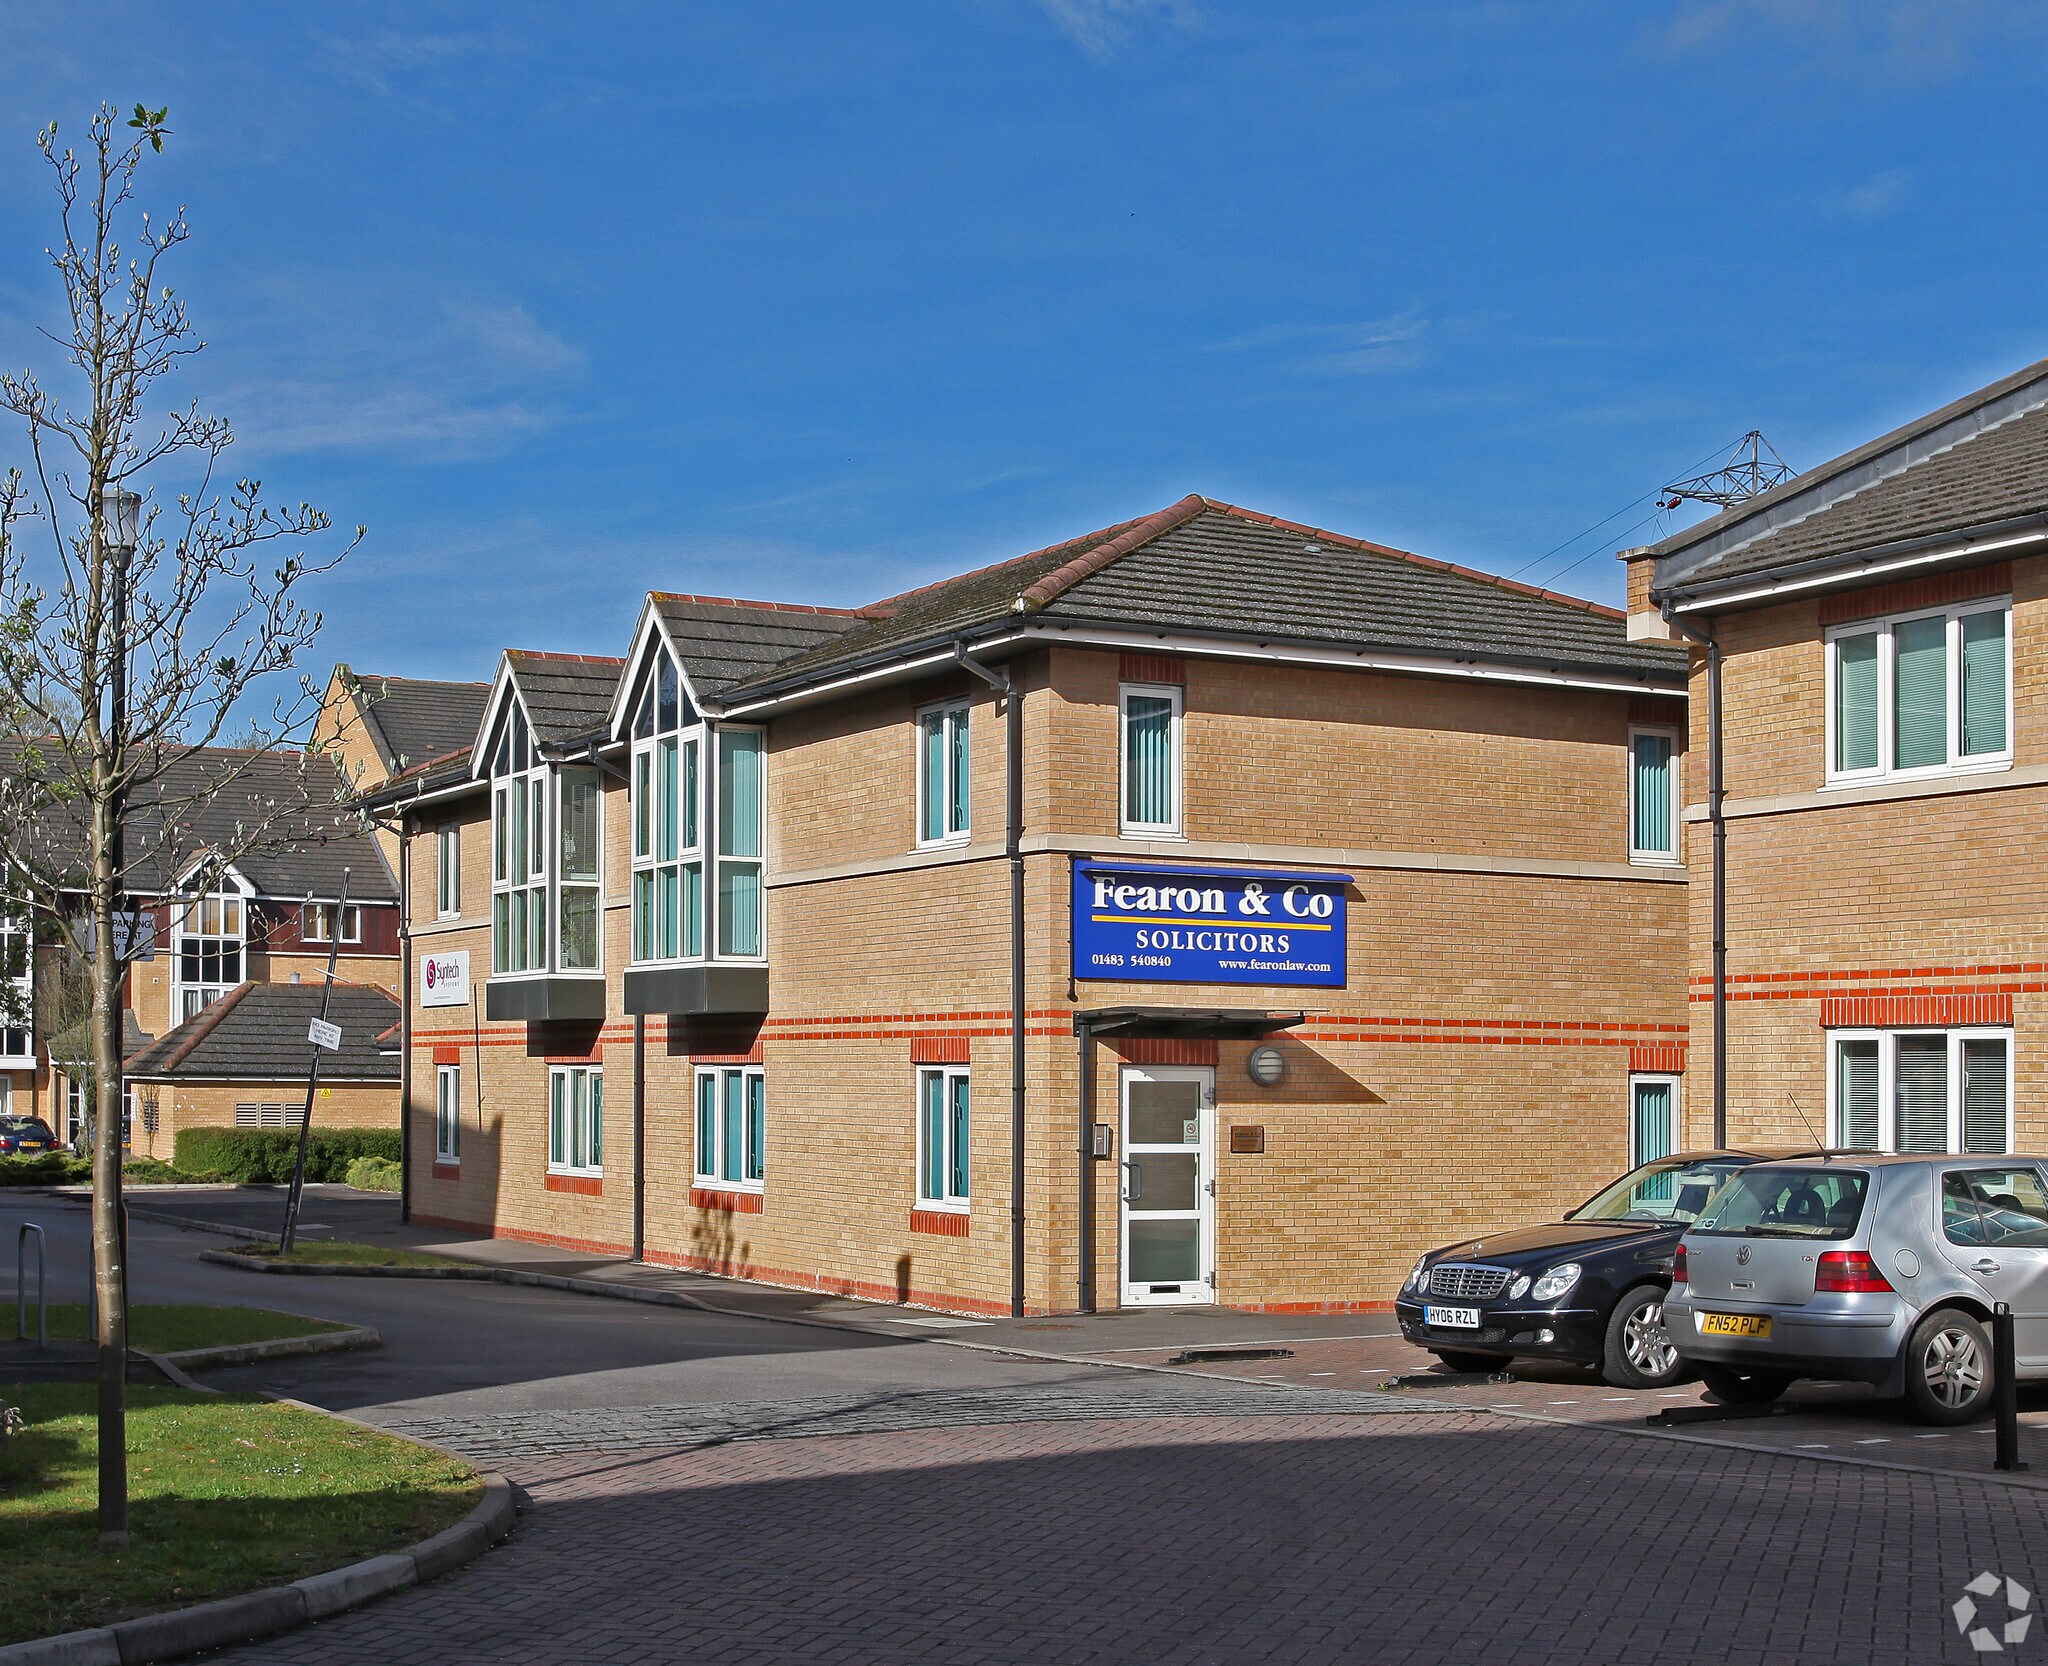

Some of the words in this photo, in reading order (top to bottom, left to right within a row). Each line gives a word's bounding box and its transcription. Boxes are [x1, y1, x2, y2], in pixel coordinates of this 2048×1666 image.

[1091, 876, 1227, 914] Fearon
[1238, 882, 1271, 916] &
[1282, 884, 1334, 918] Co
[112, 931, 128, 940] ERE
[1136, 929, 1290, 953] SOLICITORS
[1091, 953, 1125, 966] 01483
[1130, 954, 1172, 967] 540840
[1218, 958, 1331, 972] www.fearonlaw.com
[1429, 1307, 1453, 1323] HY06
[1455, 1310, 1477, 1325] RZL
[1707, 1315, 1739, 1333] FN52
[1740, 1317, 1768, 1334] PLF
